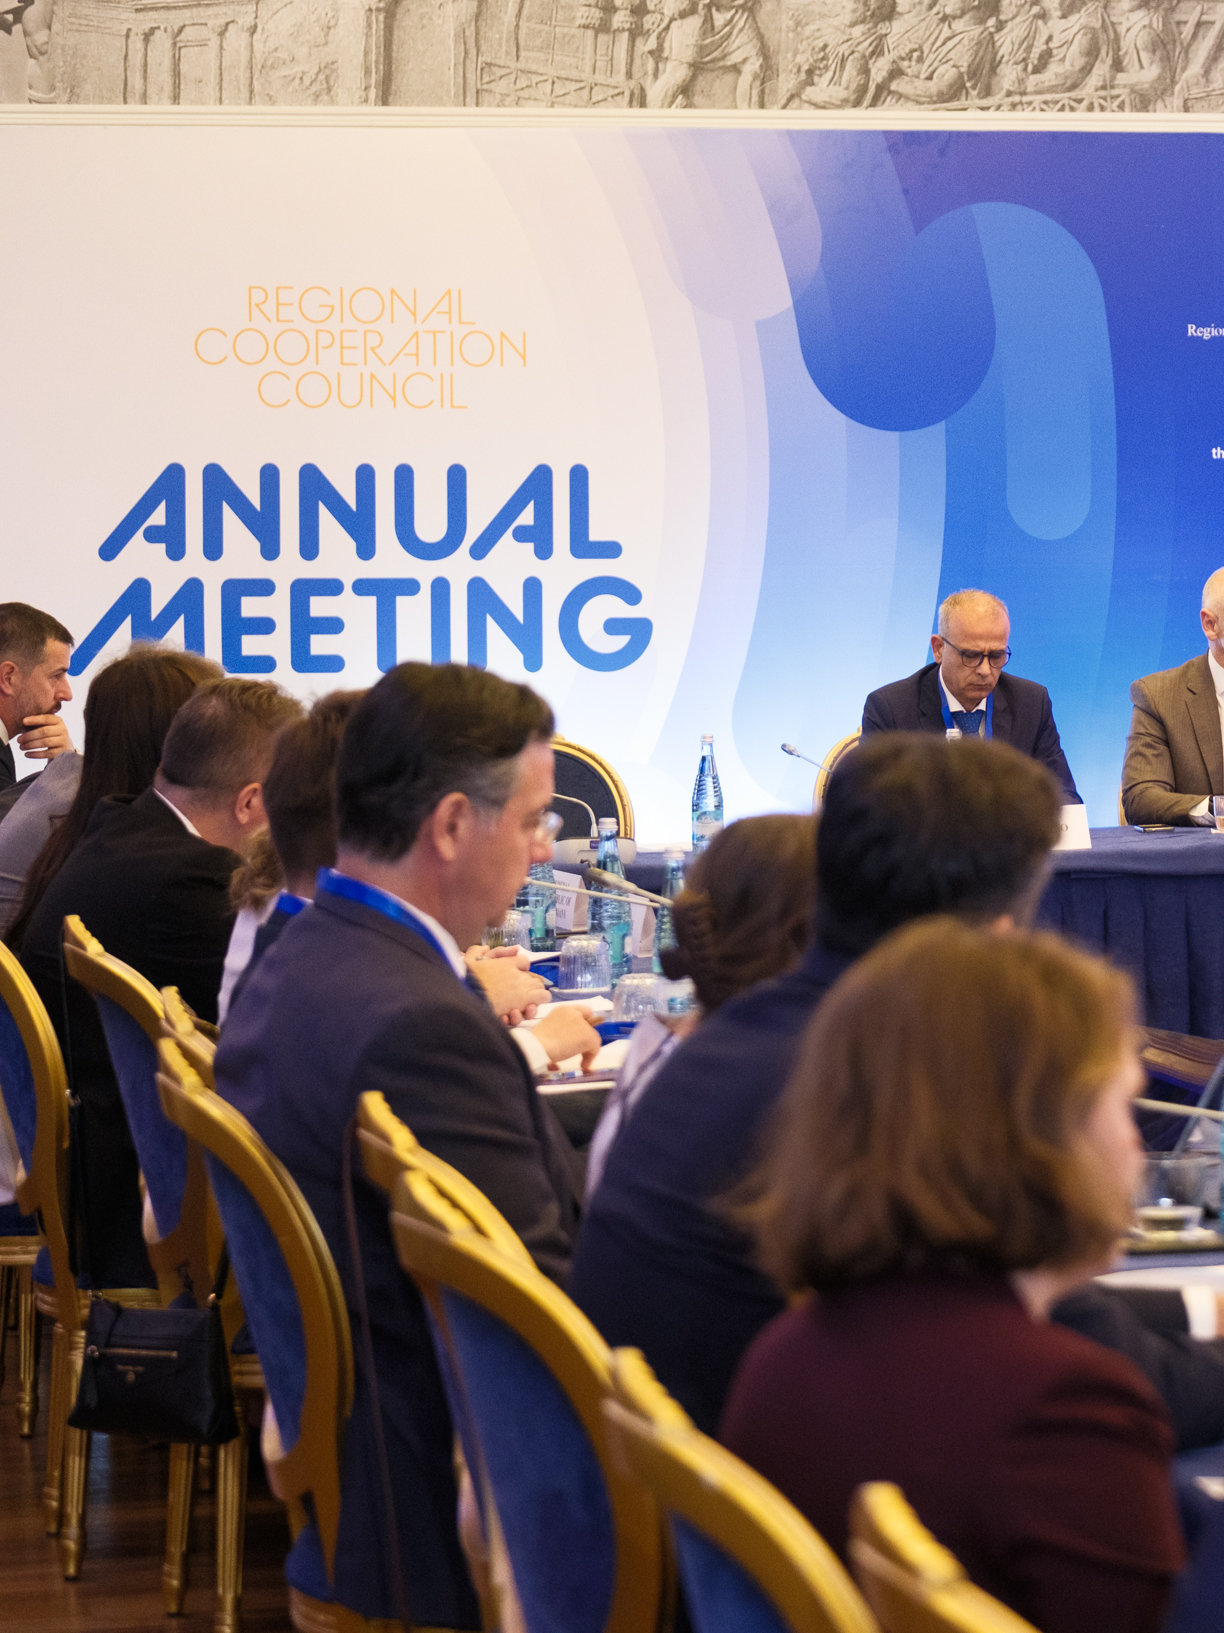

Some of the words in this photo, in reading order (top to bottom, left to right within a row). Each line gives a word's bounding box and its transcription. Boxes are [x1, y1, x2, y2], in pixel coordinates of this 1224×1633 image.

[248, 286, 476, 325] REGIONAL
[194, 327, 527, 367] COOPERATION
[257, 370, 469, 409] COUNCIL
[98, 462, 623, 562] ANNUAL
[66, 575, 654, 677] MEETING
